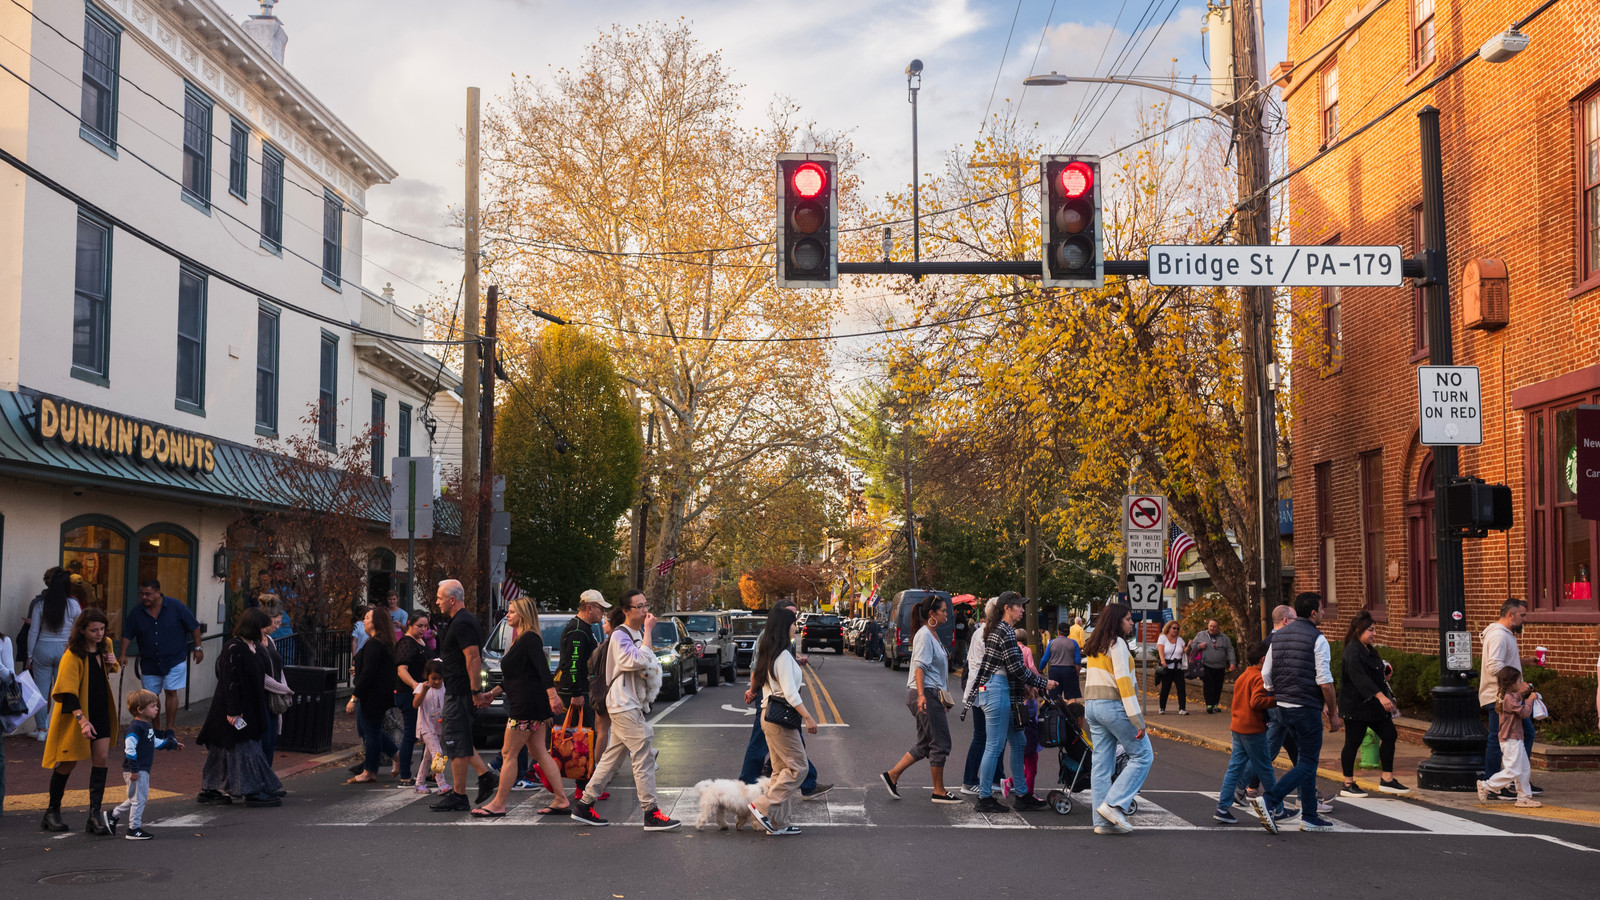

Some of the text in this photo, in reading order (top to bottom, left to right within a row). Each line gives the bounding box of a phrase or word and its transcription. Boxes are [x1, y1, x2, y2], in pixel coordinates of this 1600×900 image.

[1157, 252, 1240, 281] Bridge
[1250, 253, 1274, 275] St
[1306, 253, 1392, 275] PA-179
[1436, 372, 1462, 387] NO
[1432, 391, 1468, 402] TURN
[1425, 407, 1477, 418] ON RED
[141, 424, 215, 472] DONUTS
[1130, 560, 1161, 572] NORTH
[1132, 583, 1158, 603] 32
